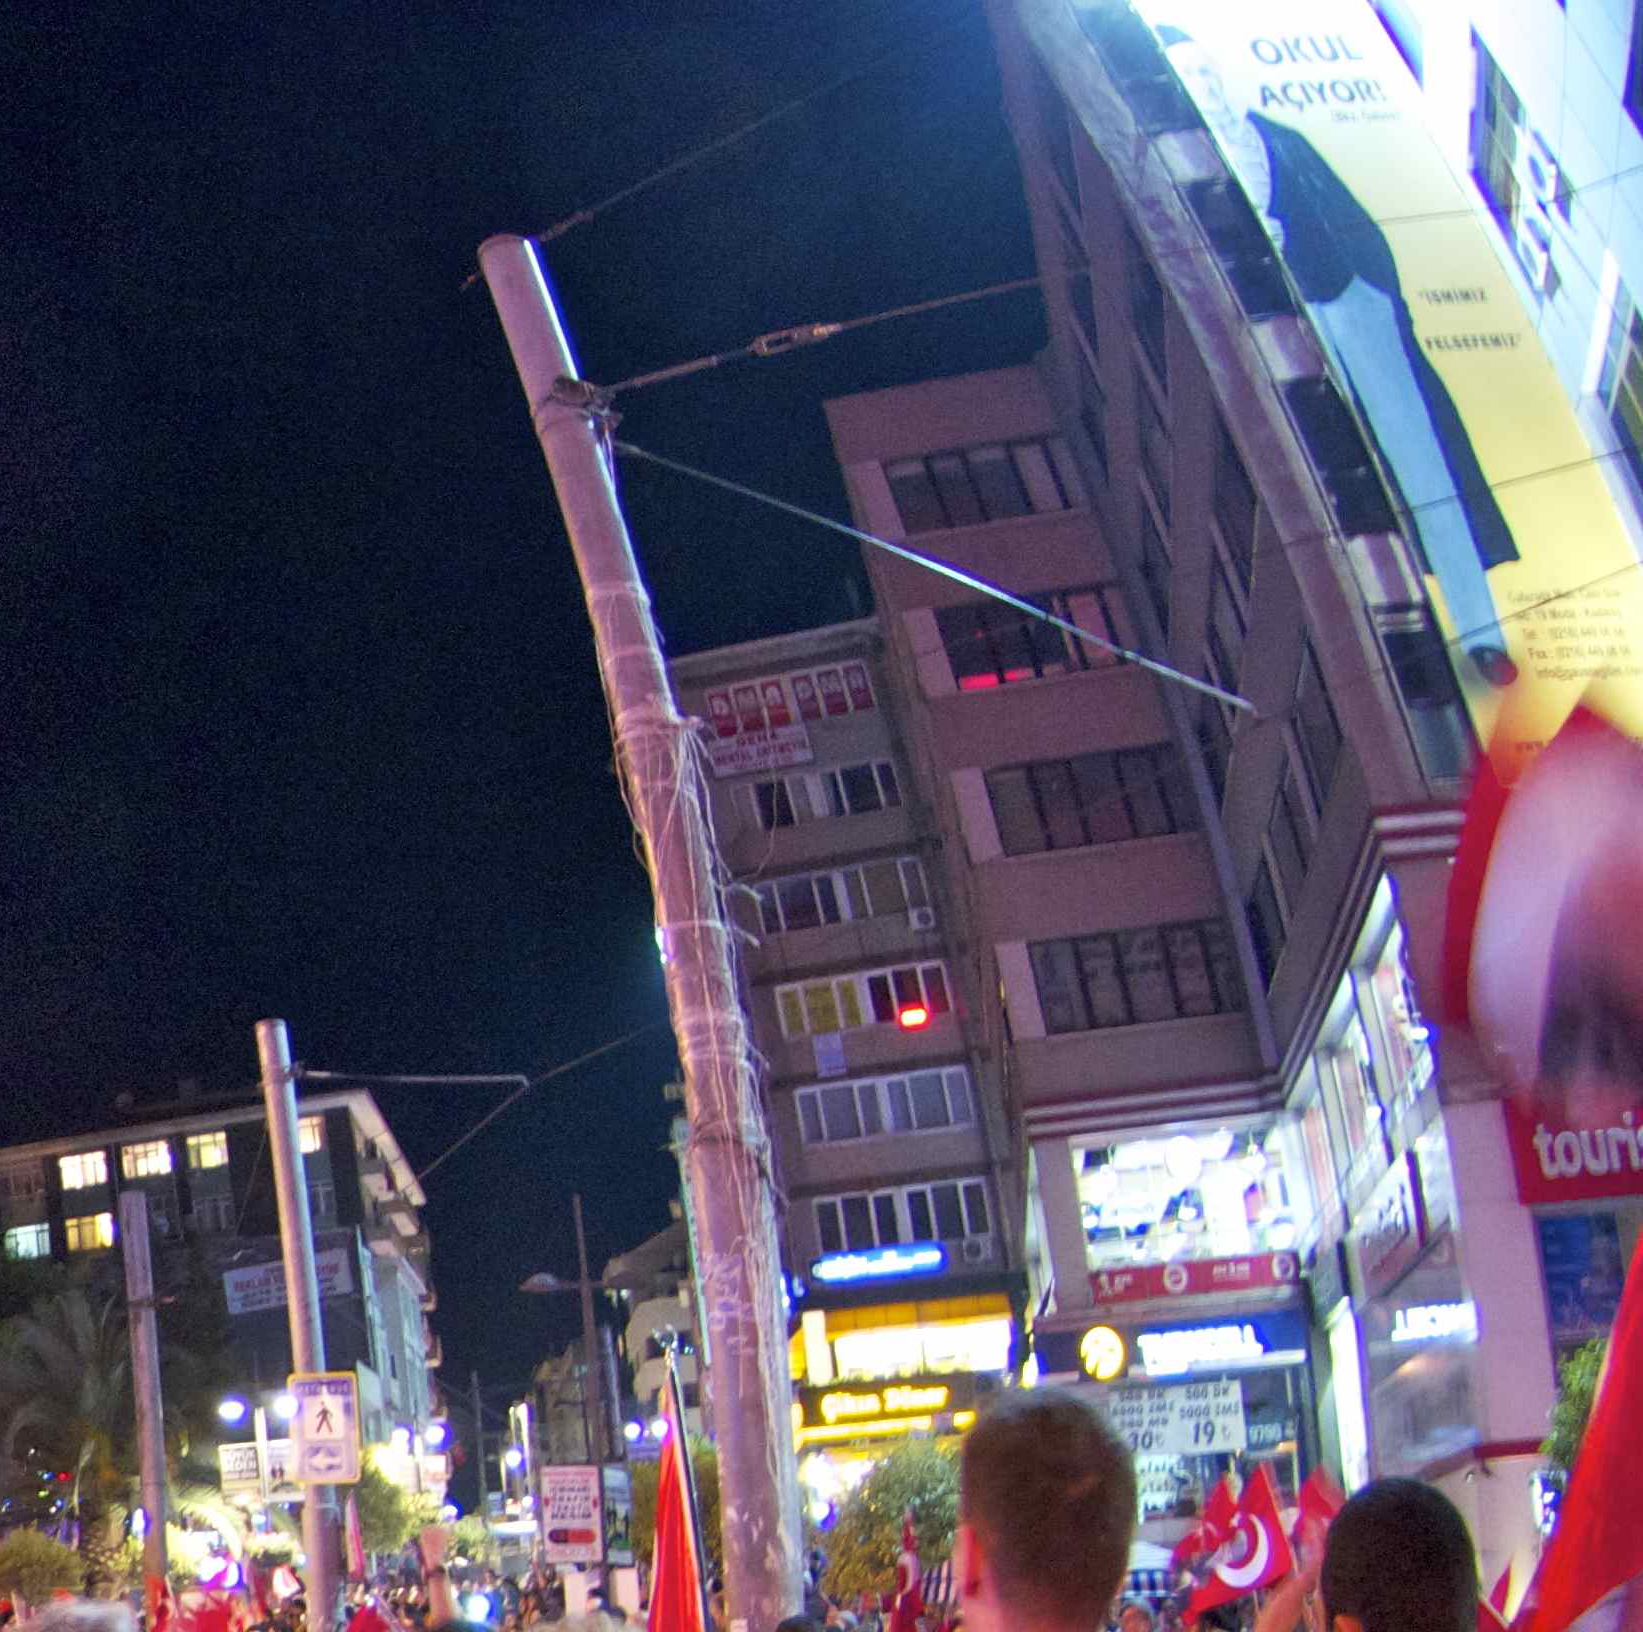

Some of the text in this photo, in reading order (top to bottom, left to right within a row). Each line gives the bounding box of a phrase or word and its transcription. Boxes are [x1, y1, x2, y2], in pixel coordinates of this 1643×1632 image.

[1250, 34, 1363, 65] OKUL
[1259, 79, 1387, 112] AÇIYOR!
[1531, 1109, 1643, 1180] touri
[1193, 1421, 1216, 1445] 19
